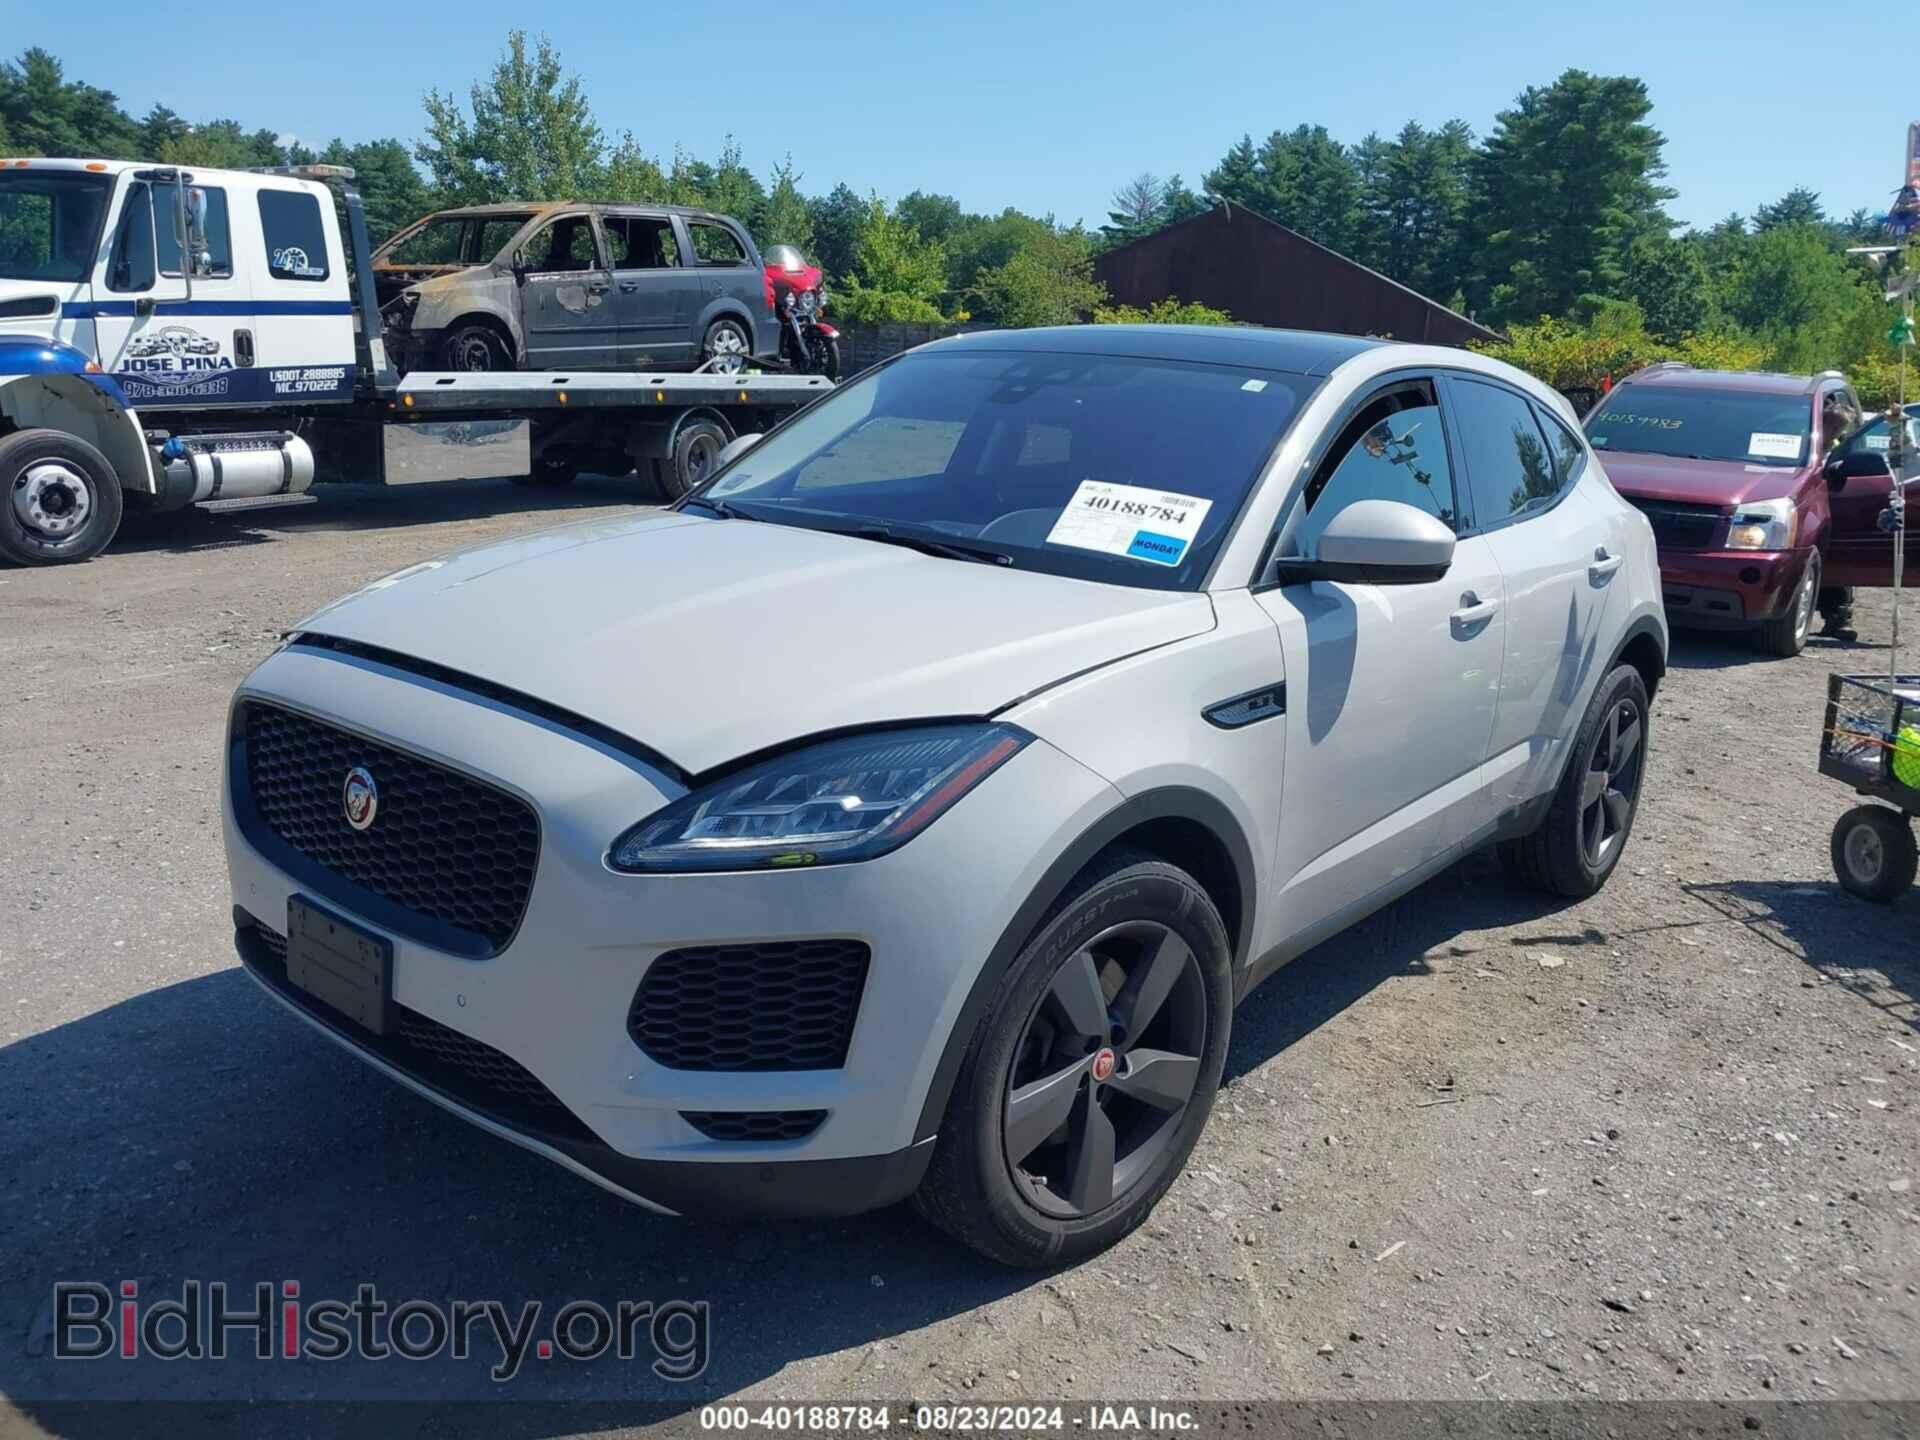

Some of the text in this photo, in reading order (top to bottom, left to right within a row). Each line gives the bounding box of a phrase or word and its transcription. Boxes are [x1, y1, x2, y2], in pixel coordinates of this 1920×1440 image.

[118, 356, 233, 373] JOSE PINA
[275, 379, 338, 394] MC.970222
[1084, 495, 1187, 524] 40188784
[1135, 539, 1181, 555] MONDAY
